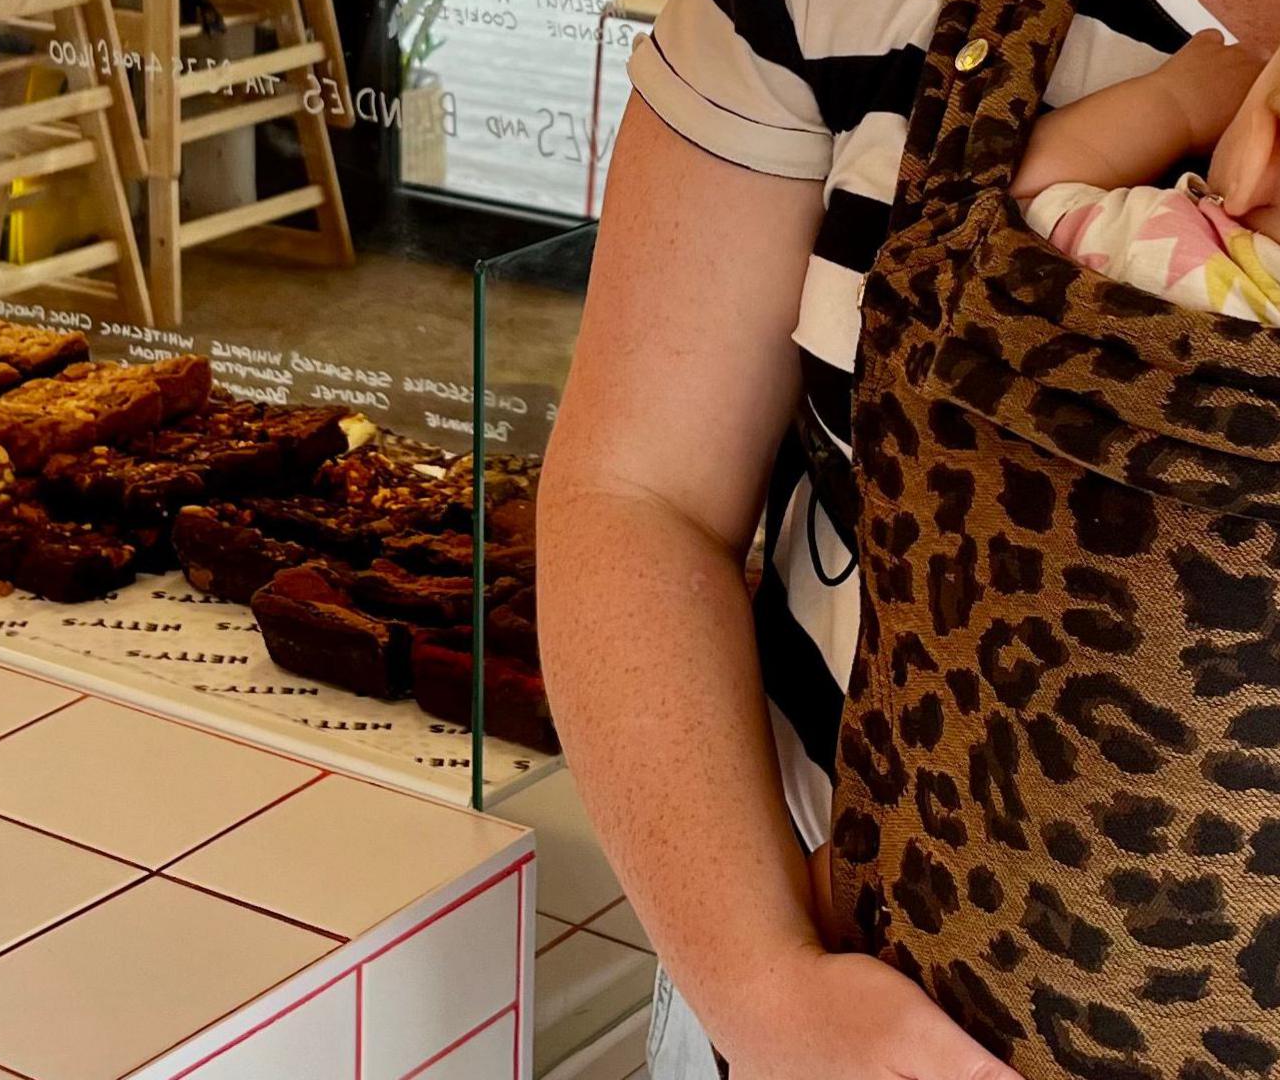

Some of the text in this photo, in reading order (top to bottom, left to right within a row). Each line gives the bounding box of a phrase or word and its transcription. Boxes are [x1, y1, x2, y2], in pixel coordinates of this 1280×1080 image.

[61, 617, 183, 633] HETTY'S
[125, 649, 250, 665] HETTY'S
[192, 685, 320, 697] HETTY'S
